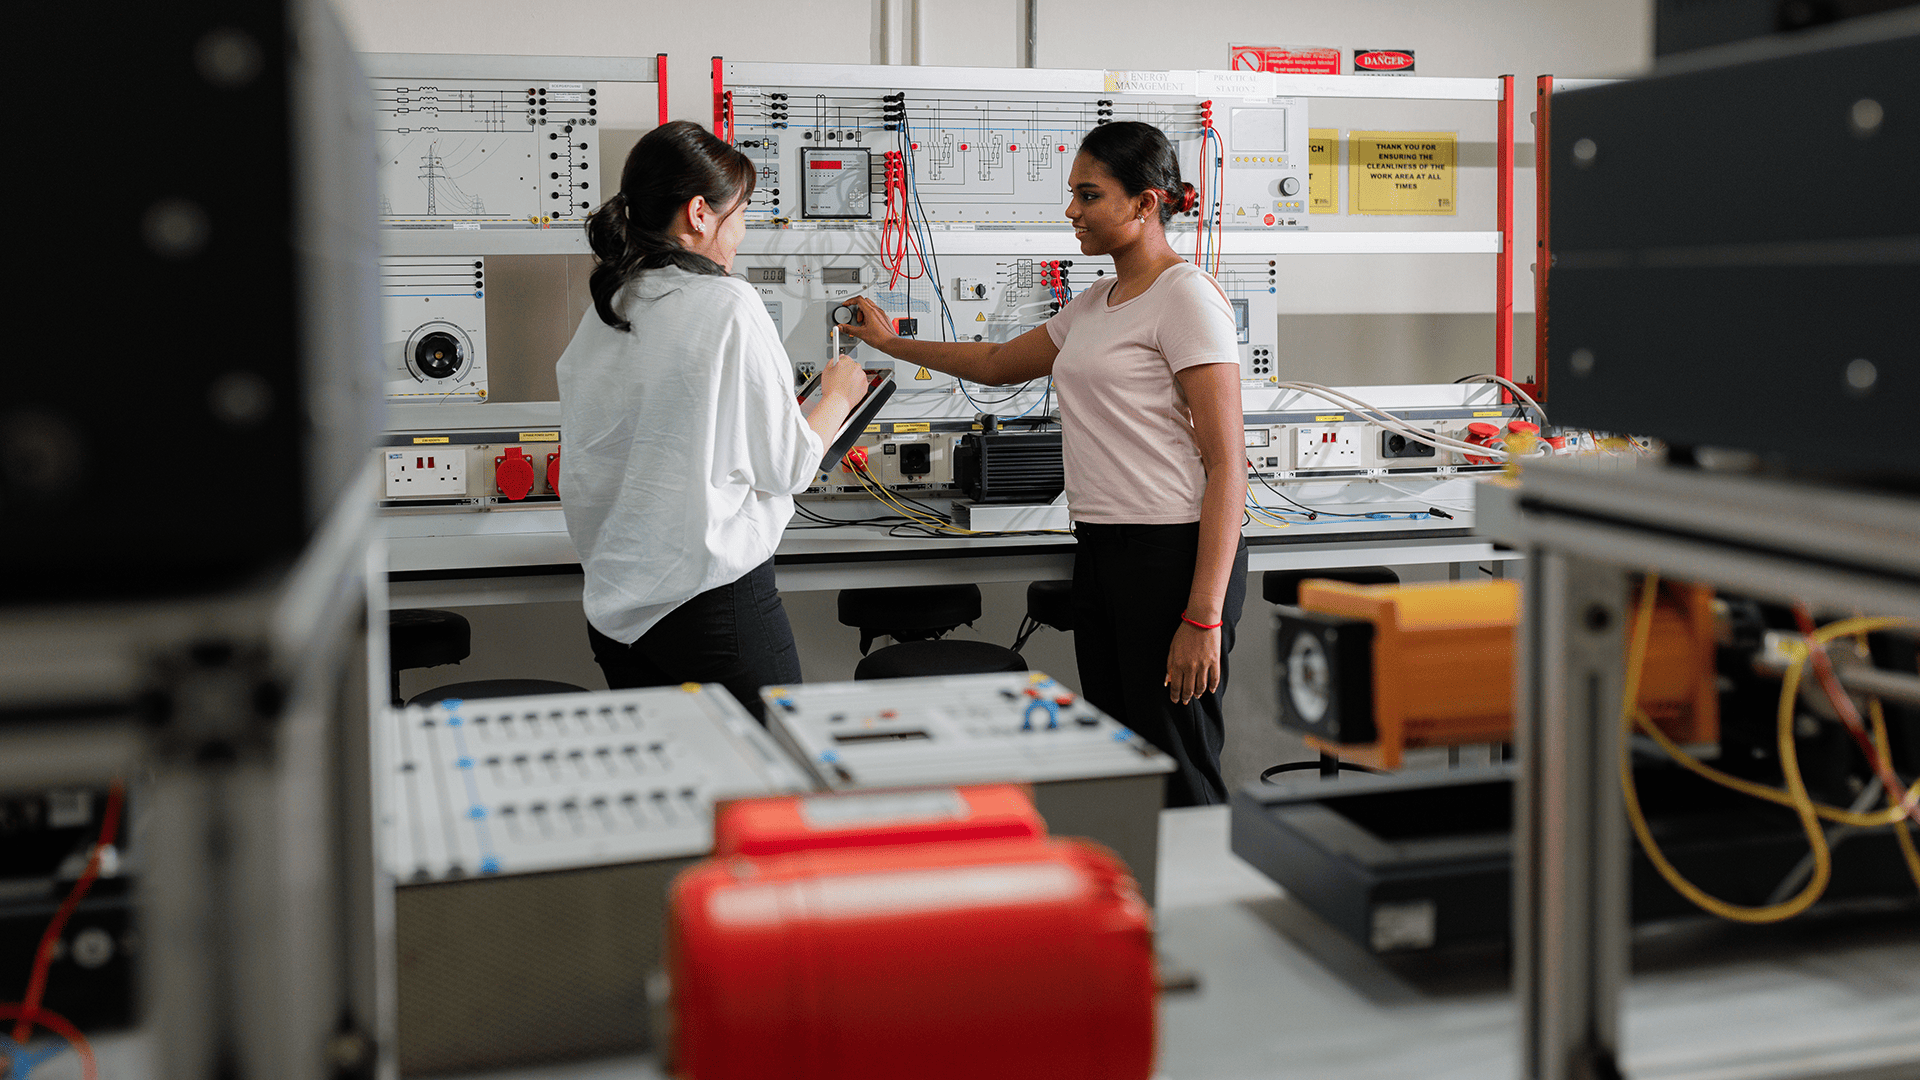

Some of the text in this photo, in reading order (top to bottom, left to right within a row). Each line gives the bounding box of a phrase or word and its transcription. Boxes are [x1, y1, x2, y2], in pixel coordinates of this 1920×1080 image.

[1364, 56, 1405, 65] DANGER
[1131, 72, 1170, 83] ENERGY
[1213, 74, 1257, 82] PRACTICAL
[1115, 81, 1185, 91] MANAGEMENT
[1216, 85, 1250, 93] STATION
[1419, 153, 1434, 161] THE
[1430, 163, 1446, 171] THE
[1428, 173, 1441, 181] ALL
[763, 270, 783, 281] 0.00
[851, 270, 858, 281] 0
